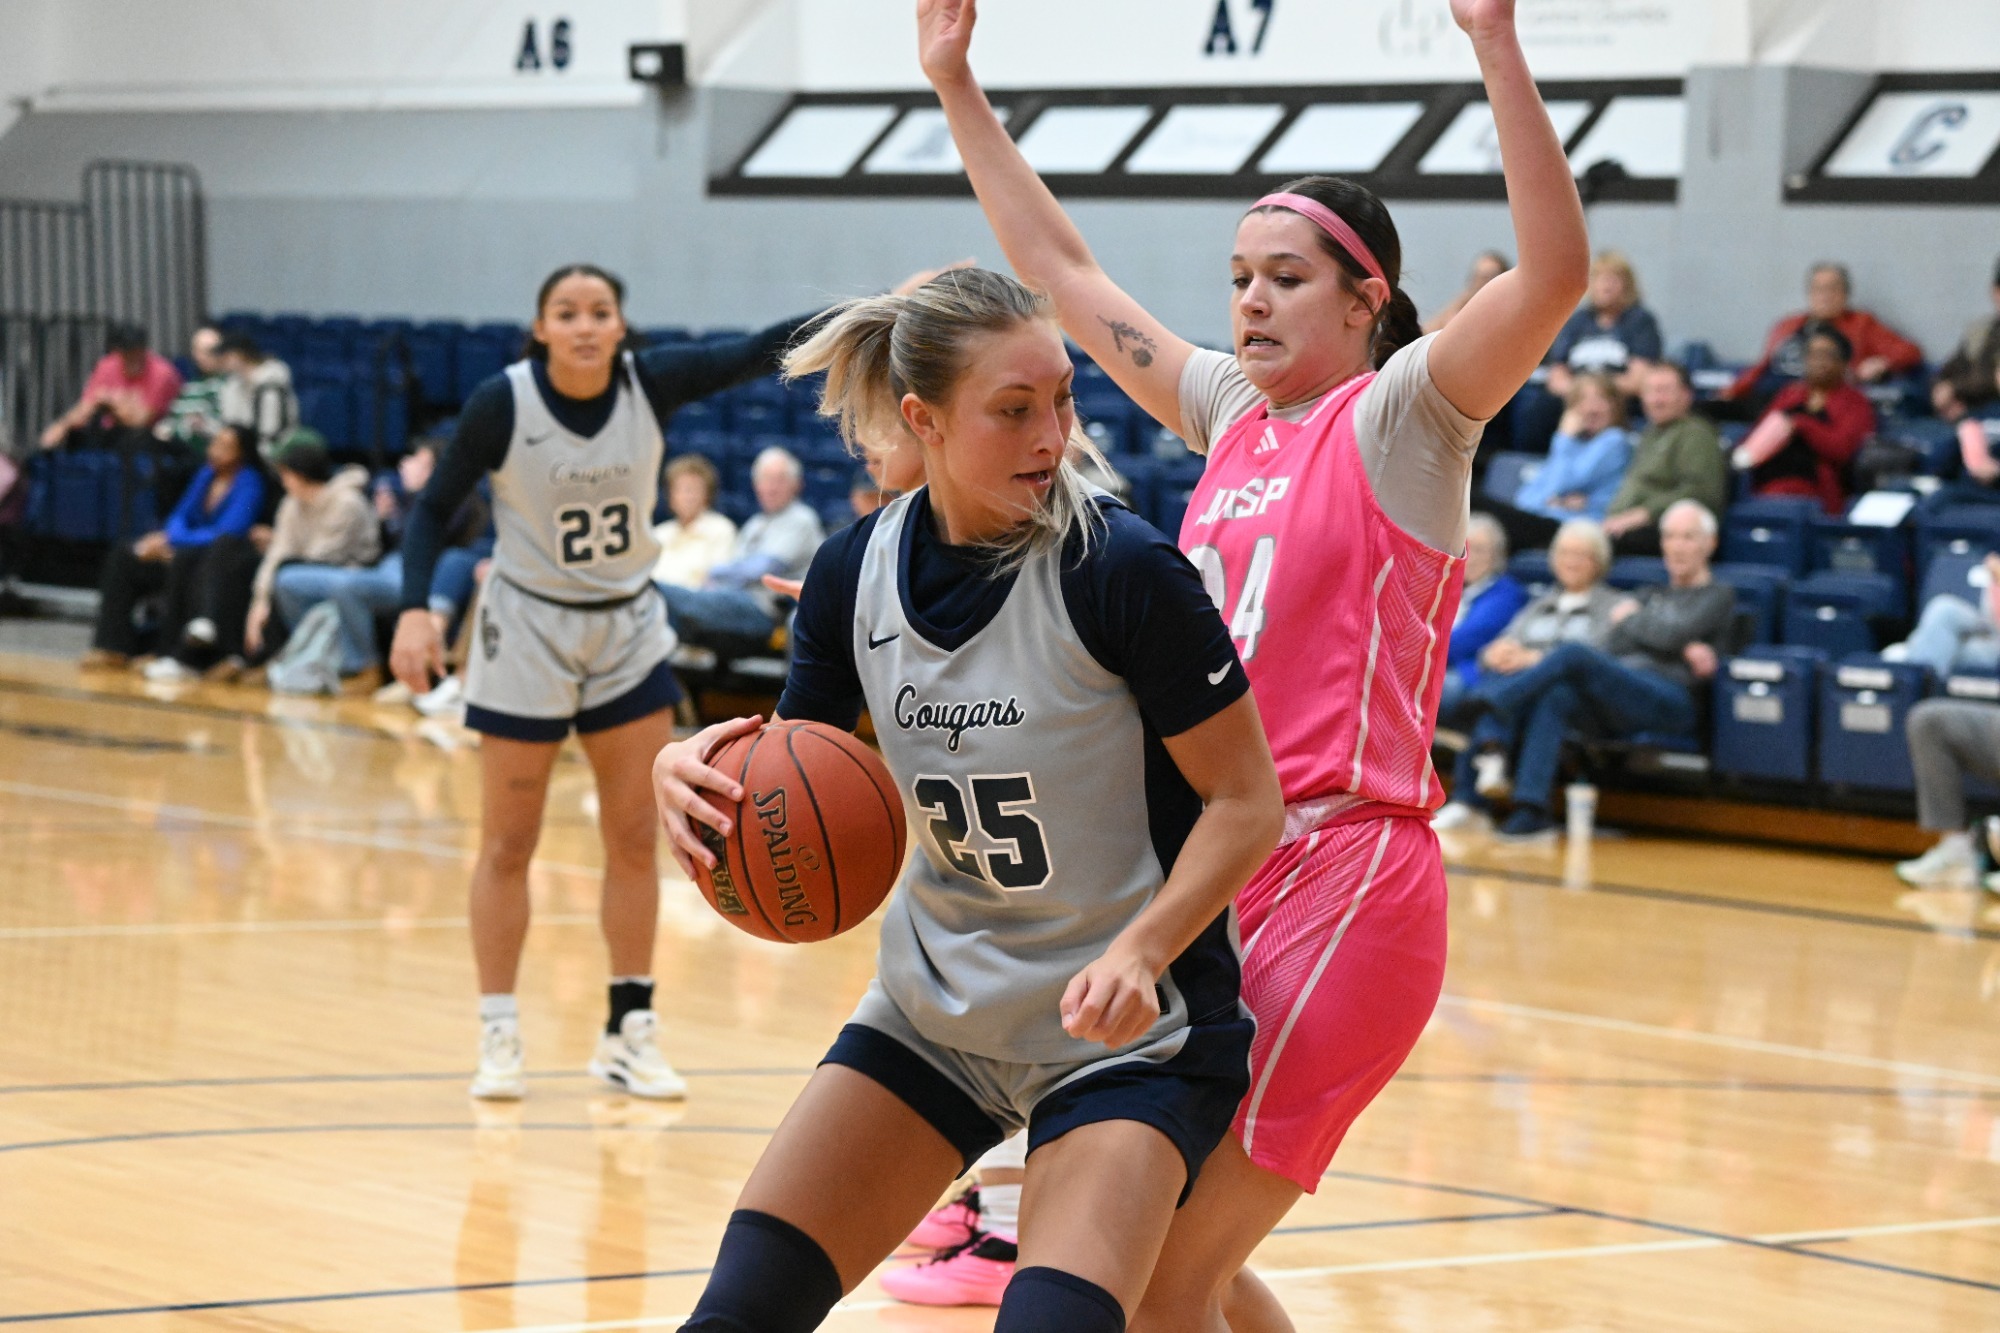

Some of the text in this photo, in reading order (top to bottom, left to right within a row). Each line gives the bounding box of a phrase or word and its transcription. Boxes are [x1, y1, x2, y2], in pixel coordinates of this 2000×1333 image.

[1203, 0, 1273, 55] A7
[555, 497, 636, 568] 23
[893, 683, 1025, 753] Cougars
[752, 786, 818, 928] SPALDING
[912, 772, 1053, 892] 25
